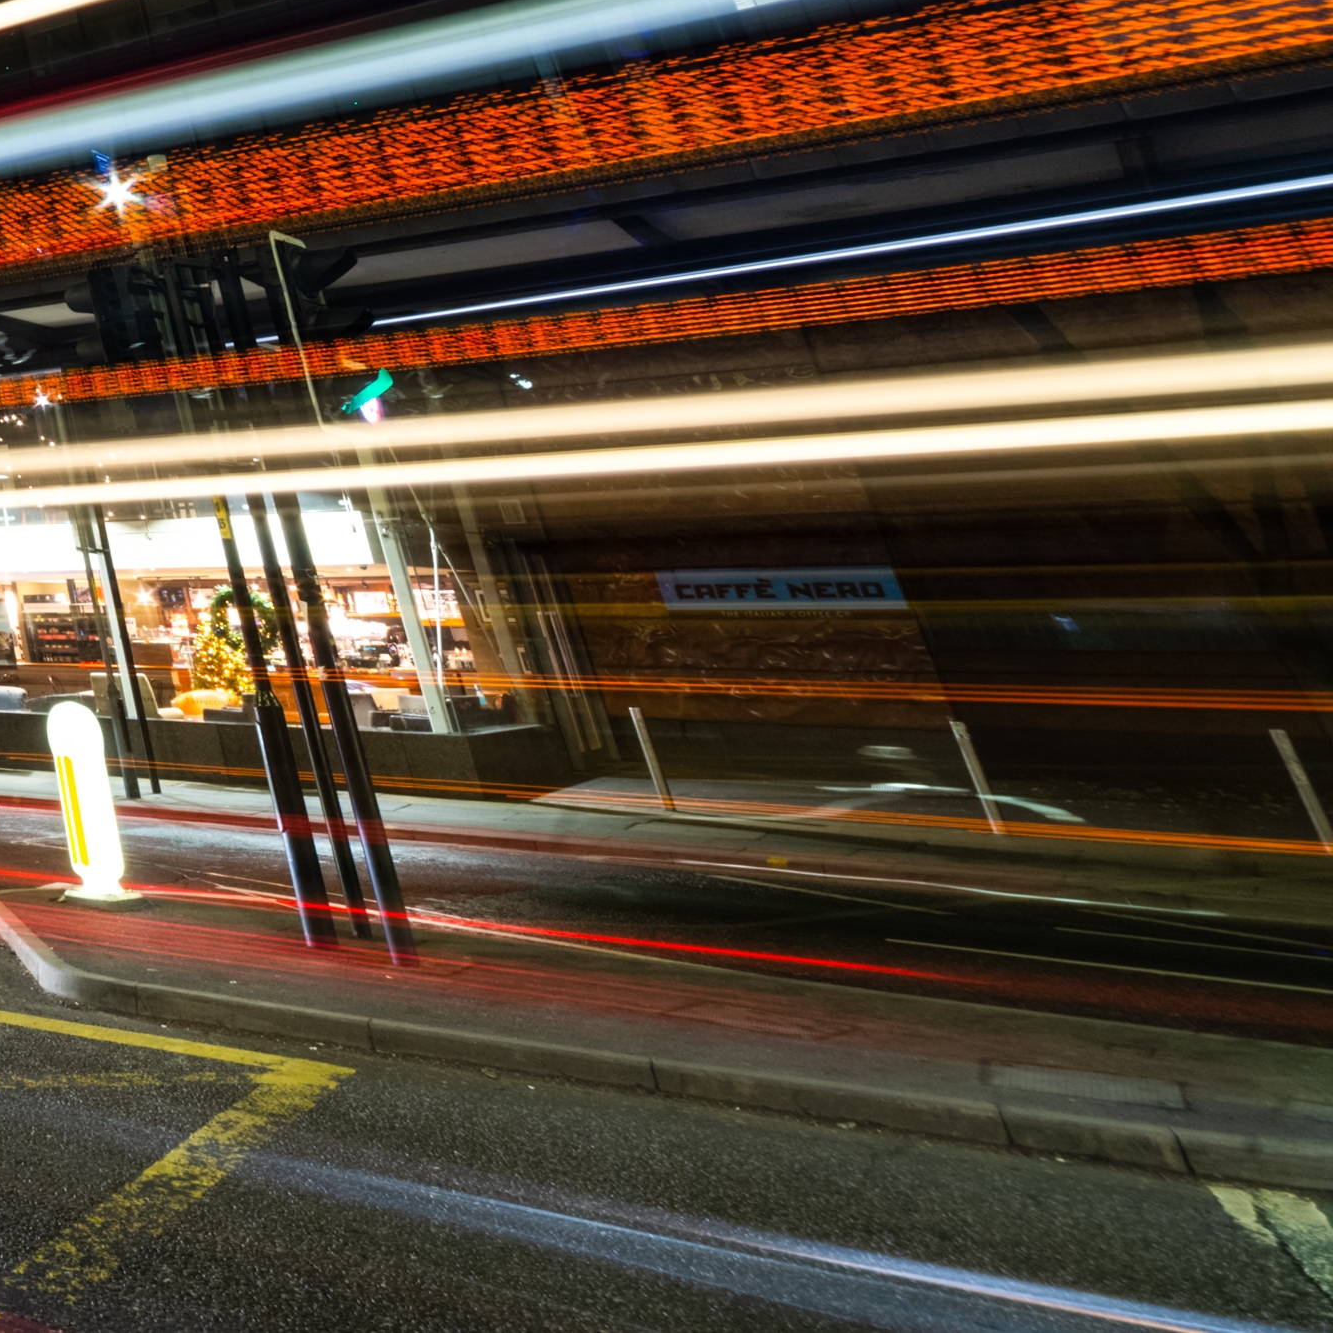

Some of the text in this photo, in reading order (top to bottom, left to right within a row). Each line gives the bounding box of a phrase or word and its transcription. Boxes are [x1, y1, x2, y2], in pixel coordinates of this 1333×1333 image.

[674, 577, 886, 601] CAFFÈ NERO
[721, 610, 740, 618] THE
